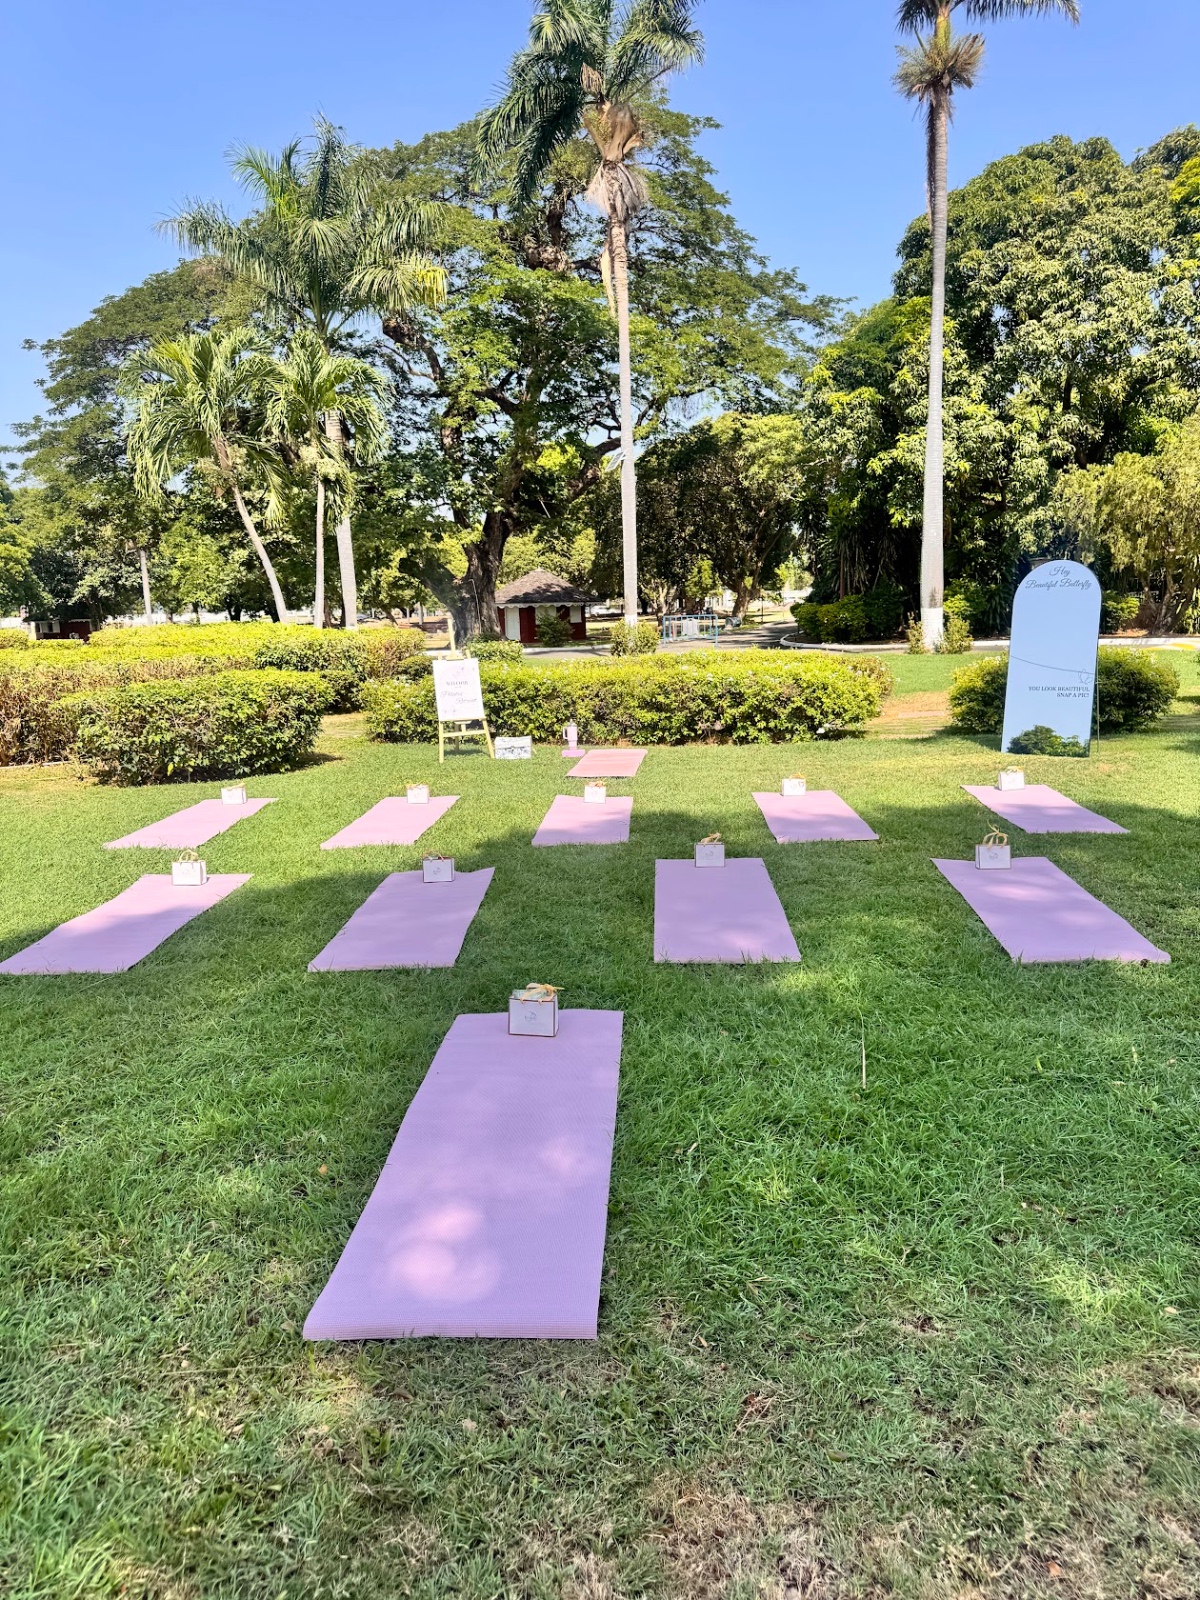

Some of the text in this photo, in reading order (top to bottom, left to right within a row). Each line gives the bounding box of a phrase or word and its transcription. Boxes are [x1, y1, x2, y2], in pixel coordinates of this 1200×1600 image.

[1049, 566, 1071, 577] Hey
[1025, 578, 1092, 590] Beautiful Butterfly
